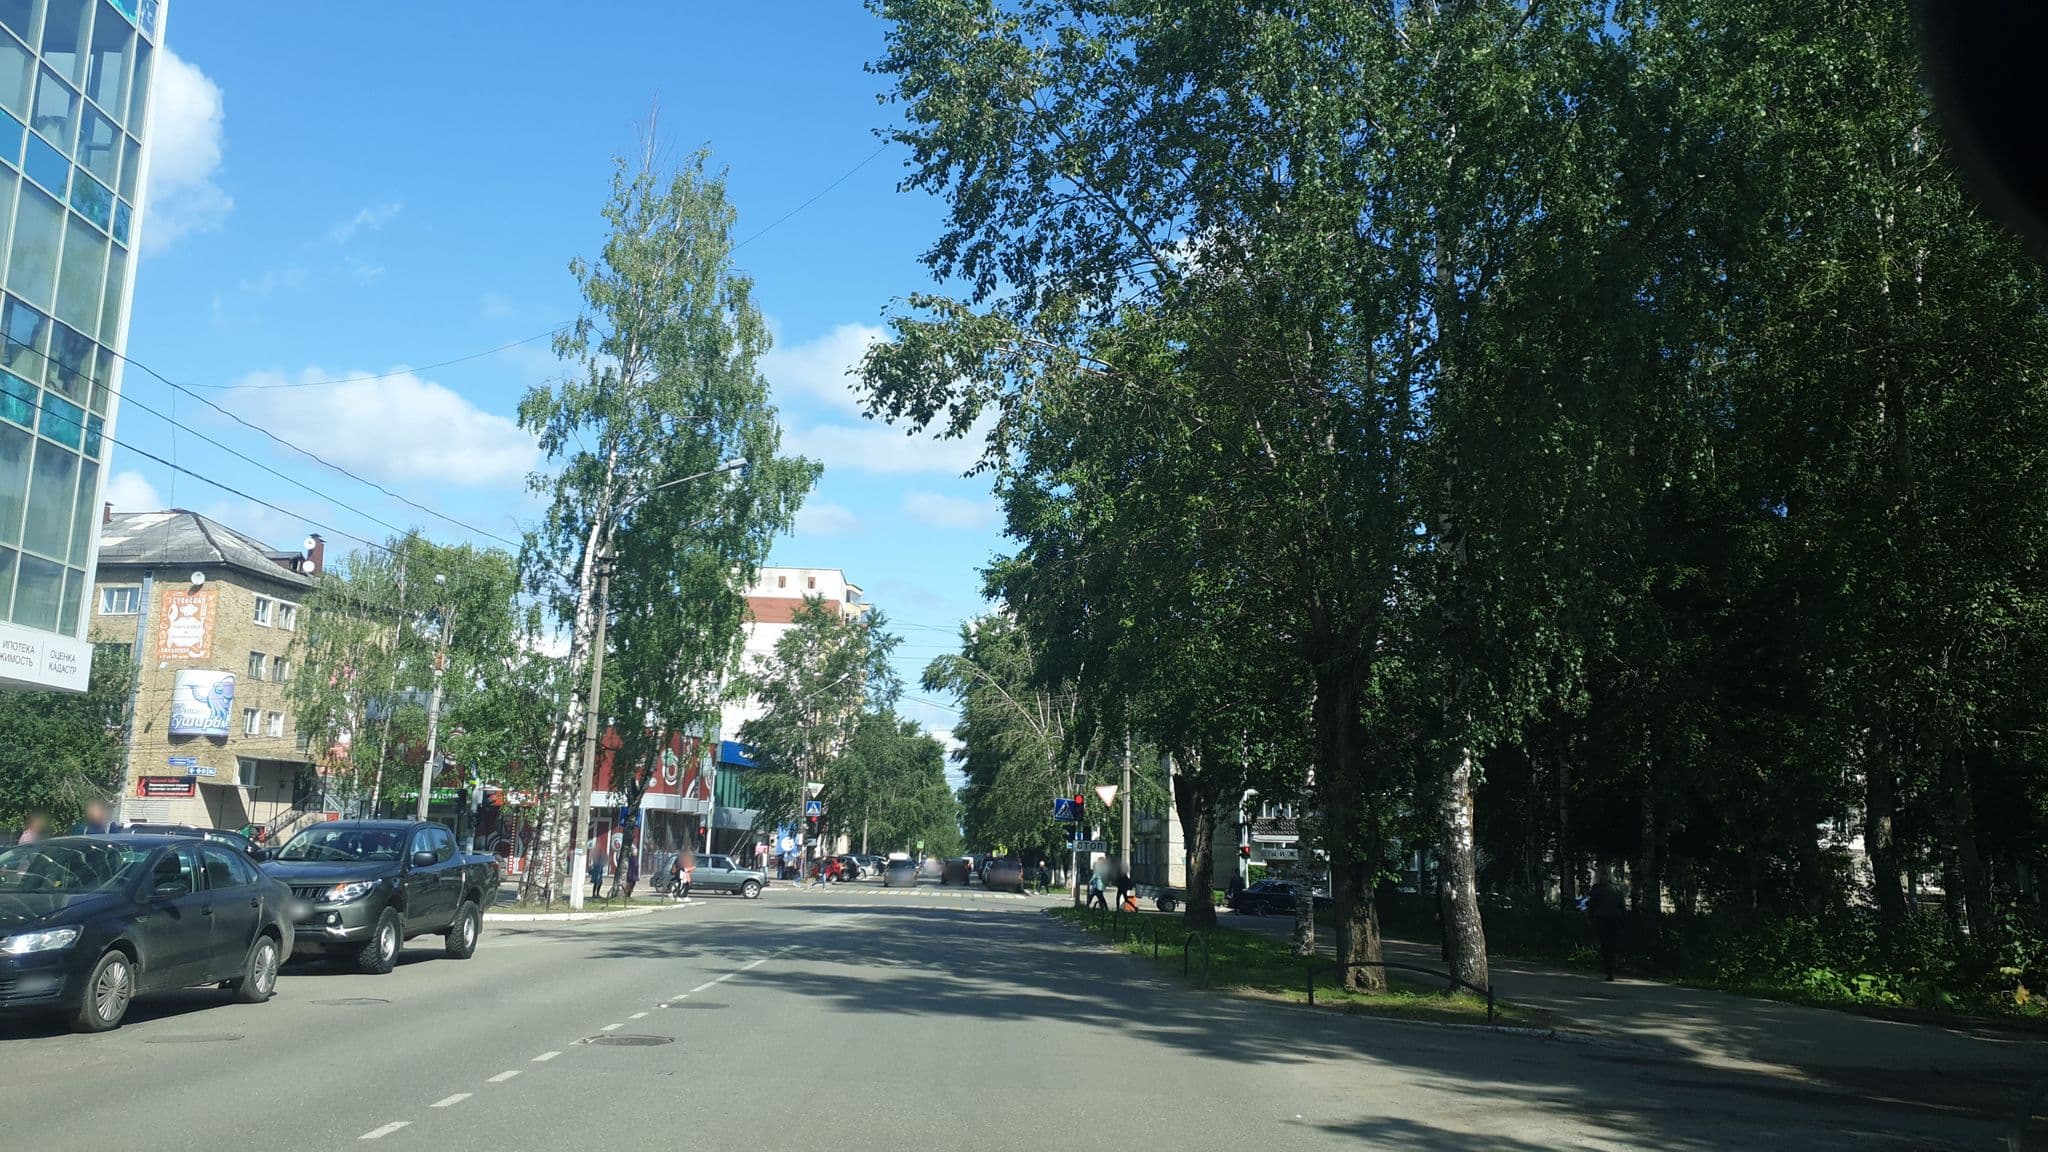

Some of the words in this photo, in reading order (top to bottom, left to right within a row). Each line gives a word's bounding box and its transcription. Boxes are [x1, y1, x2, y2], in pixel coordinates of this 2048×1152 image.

[2, 640, 35, 654] ИПОТЕКА
[50, 650, 76, 663] ОЦЕНКА
[48, 662, 78, 675] КАДАСТР
[1077, 842, 1103, 850] СТОП
